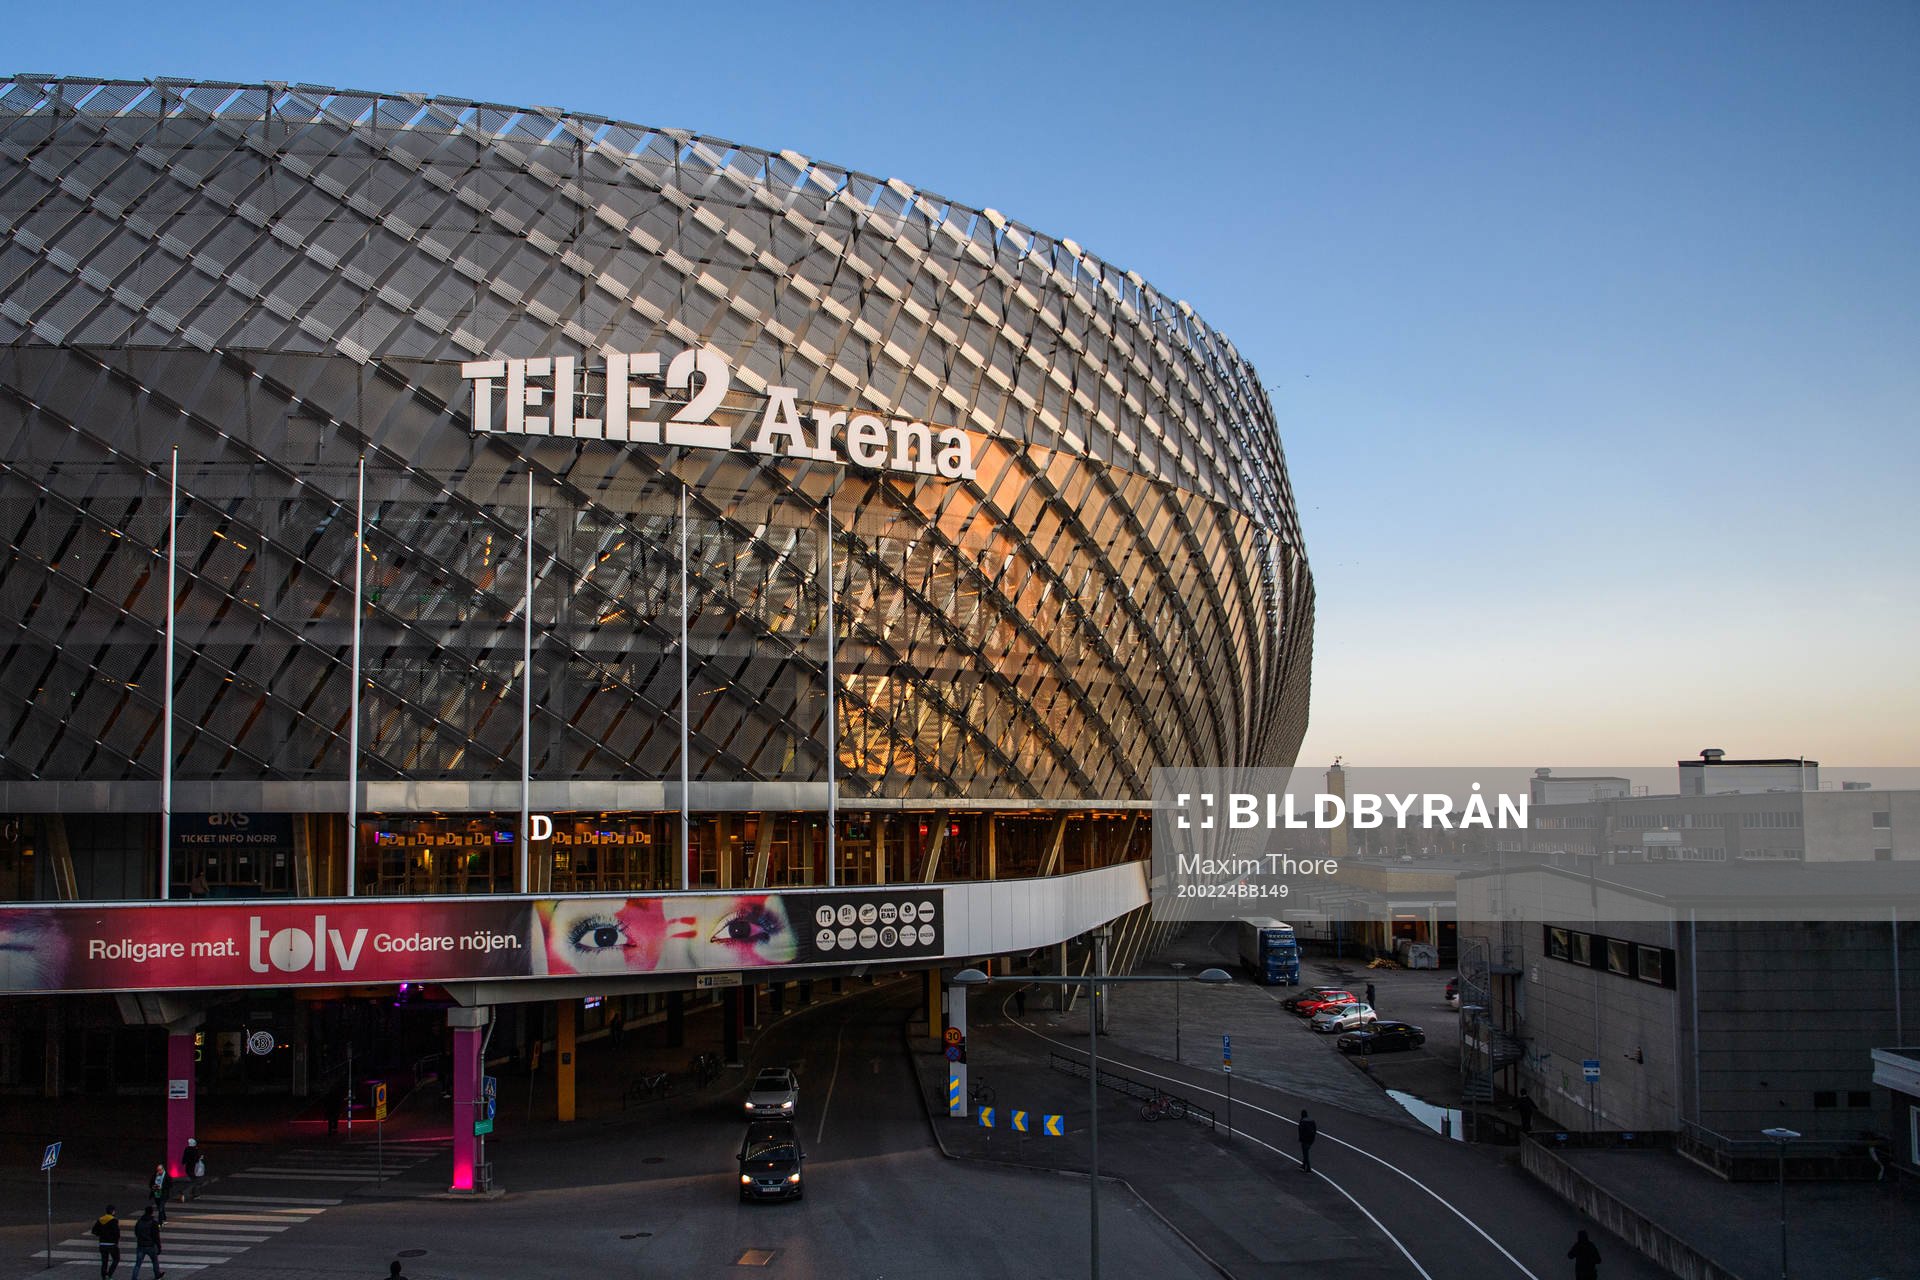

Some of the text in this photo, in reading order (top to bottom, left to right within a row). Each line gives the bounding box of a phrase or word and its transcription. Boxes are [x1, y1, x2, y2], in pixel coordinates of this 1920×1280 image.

[461, 349, 977, 480] TELE2 Arena
[180, 834, 278, 843] TICKET INFO NORR
[530, 815, 553, 841] D
[89, 937, 240, 963] Roligare mat.
[249, 914, 369, 973] tolv
[373, 930, 522, 953] Godare nöjen.
[948, 1032, 959, 1040] 30
